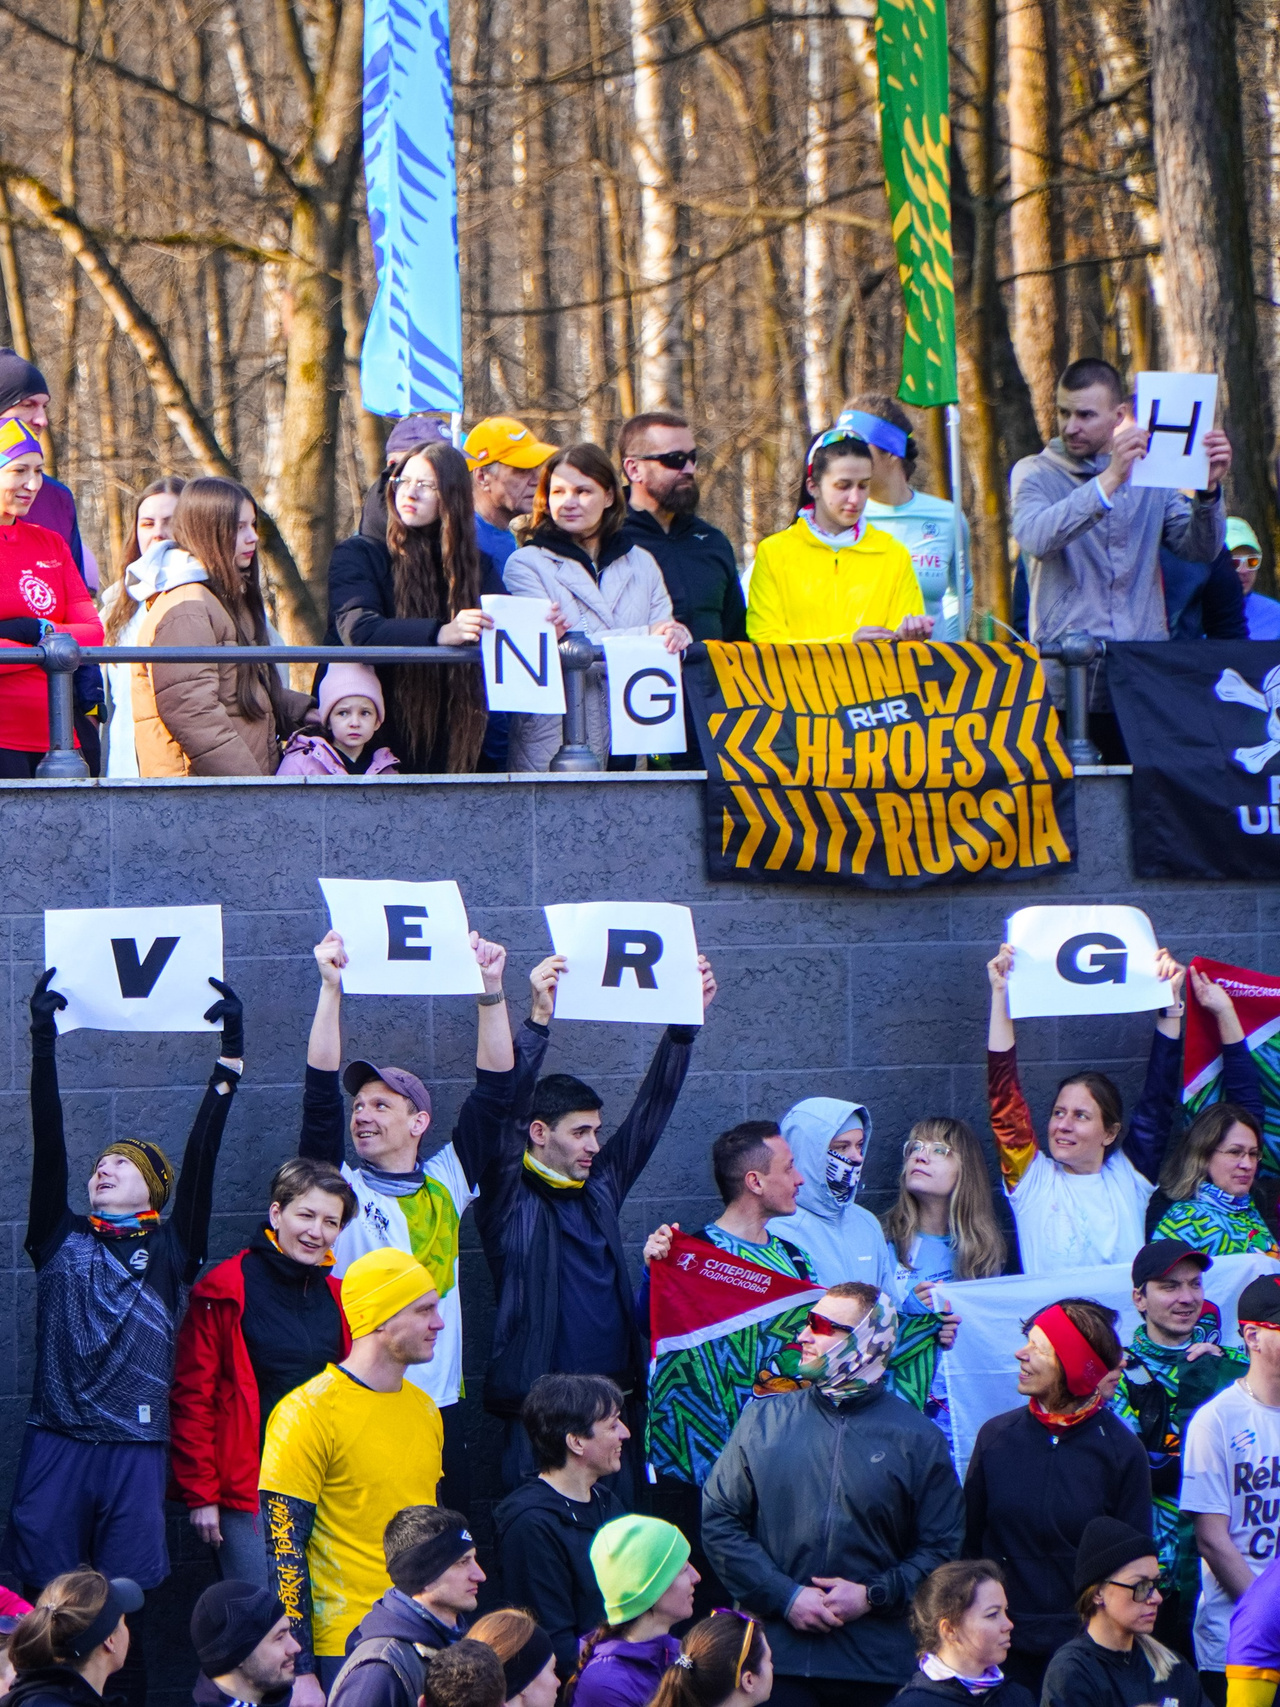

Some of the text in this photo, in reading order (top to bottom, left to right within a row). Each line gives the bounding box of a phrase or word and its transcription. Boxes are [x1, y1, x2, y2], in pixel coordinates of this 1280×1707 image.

[1147, 399, 1202, 456] H
[494, 629, 548, 687] N
[706, 640, 941, 716] RUNNING
[623, 667, 677, 726] G
[846, 699, 911, 731] RHR
[793, 711, 987, 790] HEROES
[875, 783, 1072, 877] RUSSIA
[383, 905, 432, 961] E
[601, 928, 663, 989] R
[1056, 932, 1128, 985] G
[110, 936, 181, 999] V
[699, 1268, 769, 1294] ПОДМОСКОВЬЯ
[705, 1258, 773, 1287] СУПЕРЛИГА
